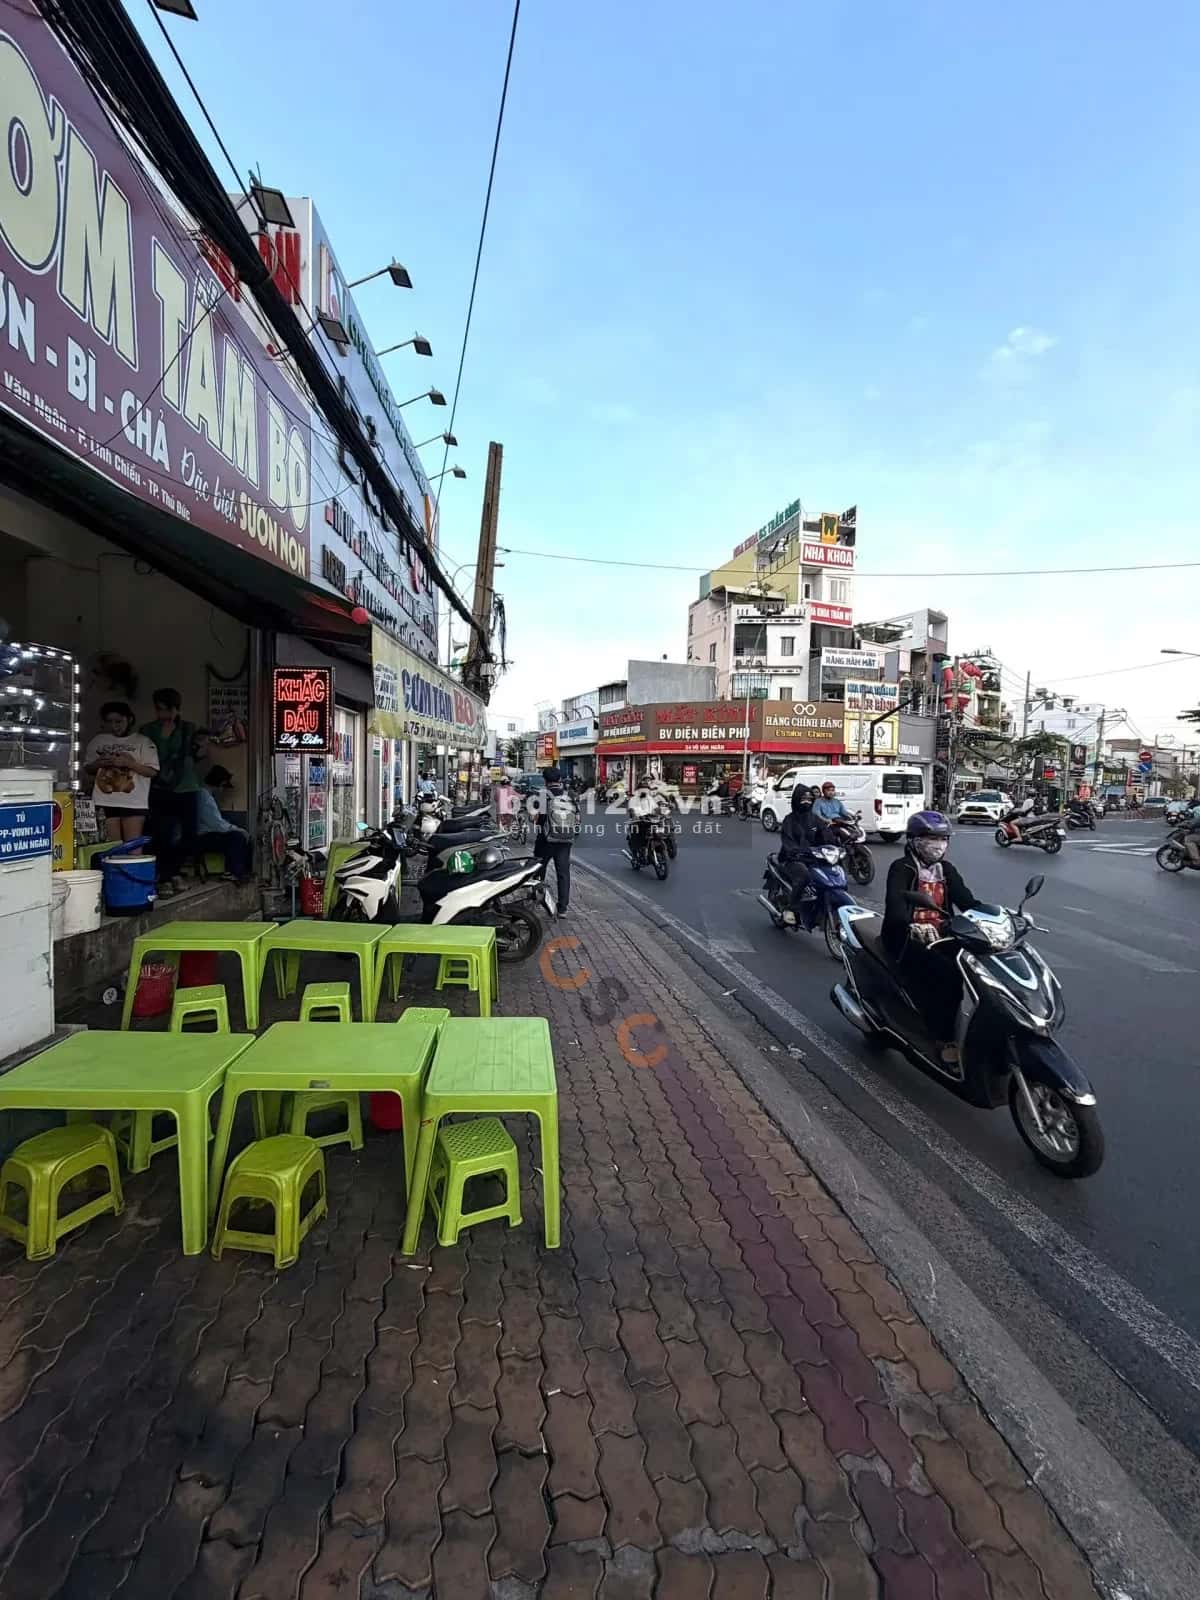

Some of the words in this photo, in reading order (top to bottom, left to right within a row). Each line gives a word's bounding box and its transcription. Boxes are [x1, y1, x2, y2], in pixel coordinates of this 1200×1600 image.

[151, 235, 259, 490] TẤM
[68, 336, 96, 413] BÌ
[120, 389, 170, 473] CHẢ
[280, 526, 307, 578] NON
[804, 545, 825, 561] NHA
[826, 549, 853, 565] KHOA
[278, 672, 326, 703] KHẮC
[659, 728, 673, 740] BV
[674, 725, 699, 742] ĐIỆN
[701, 724, 726, 740] BIÊN
